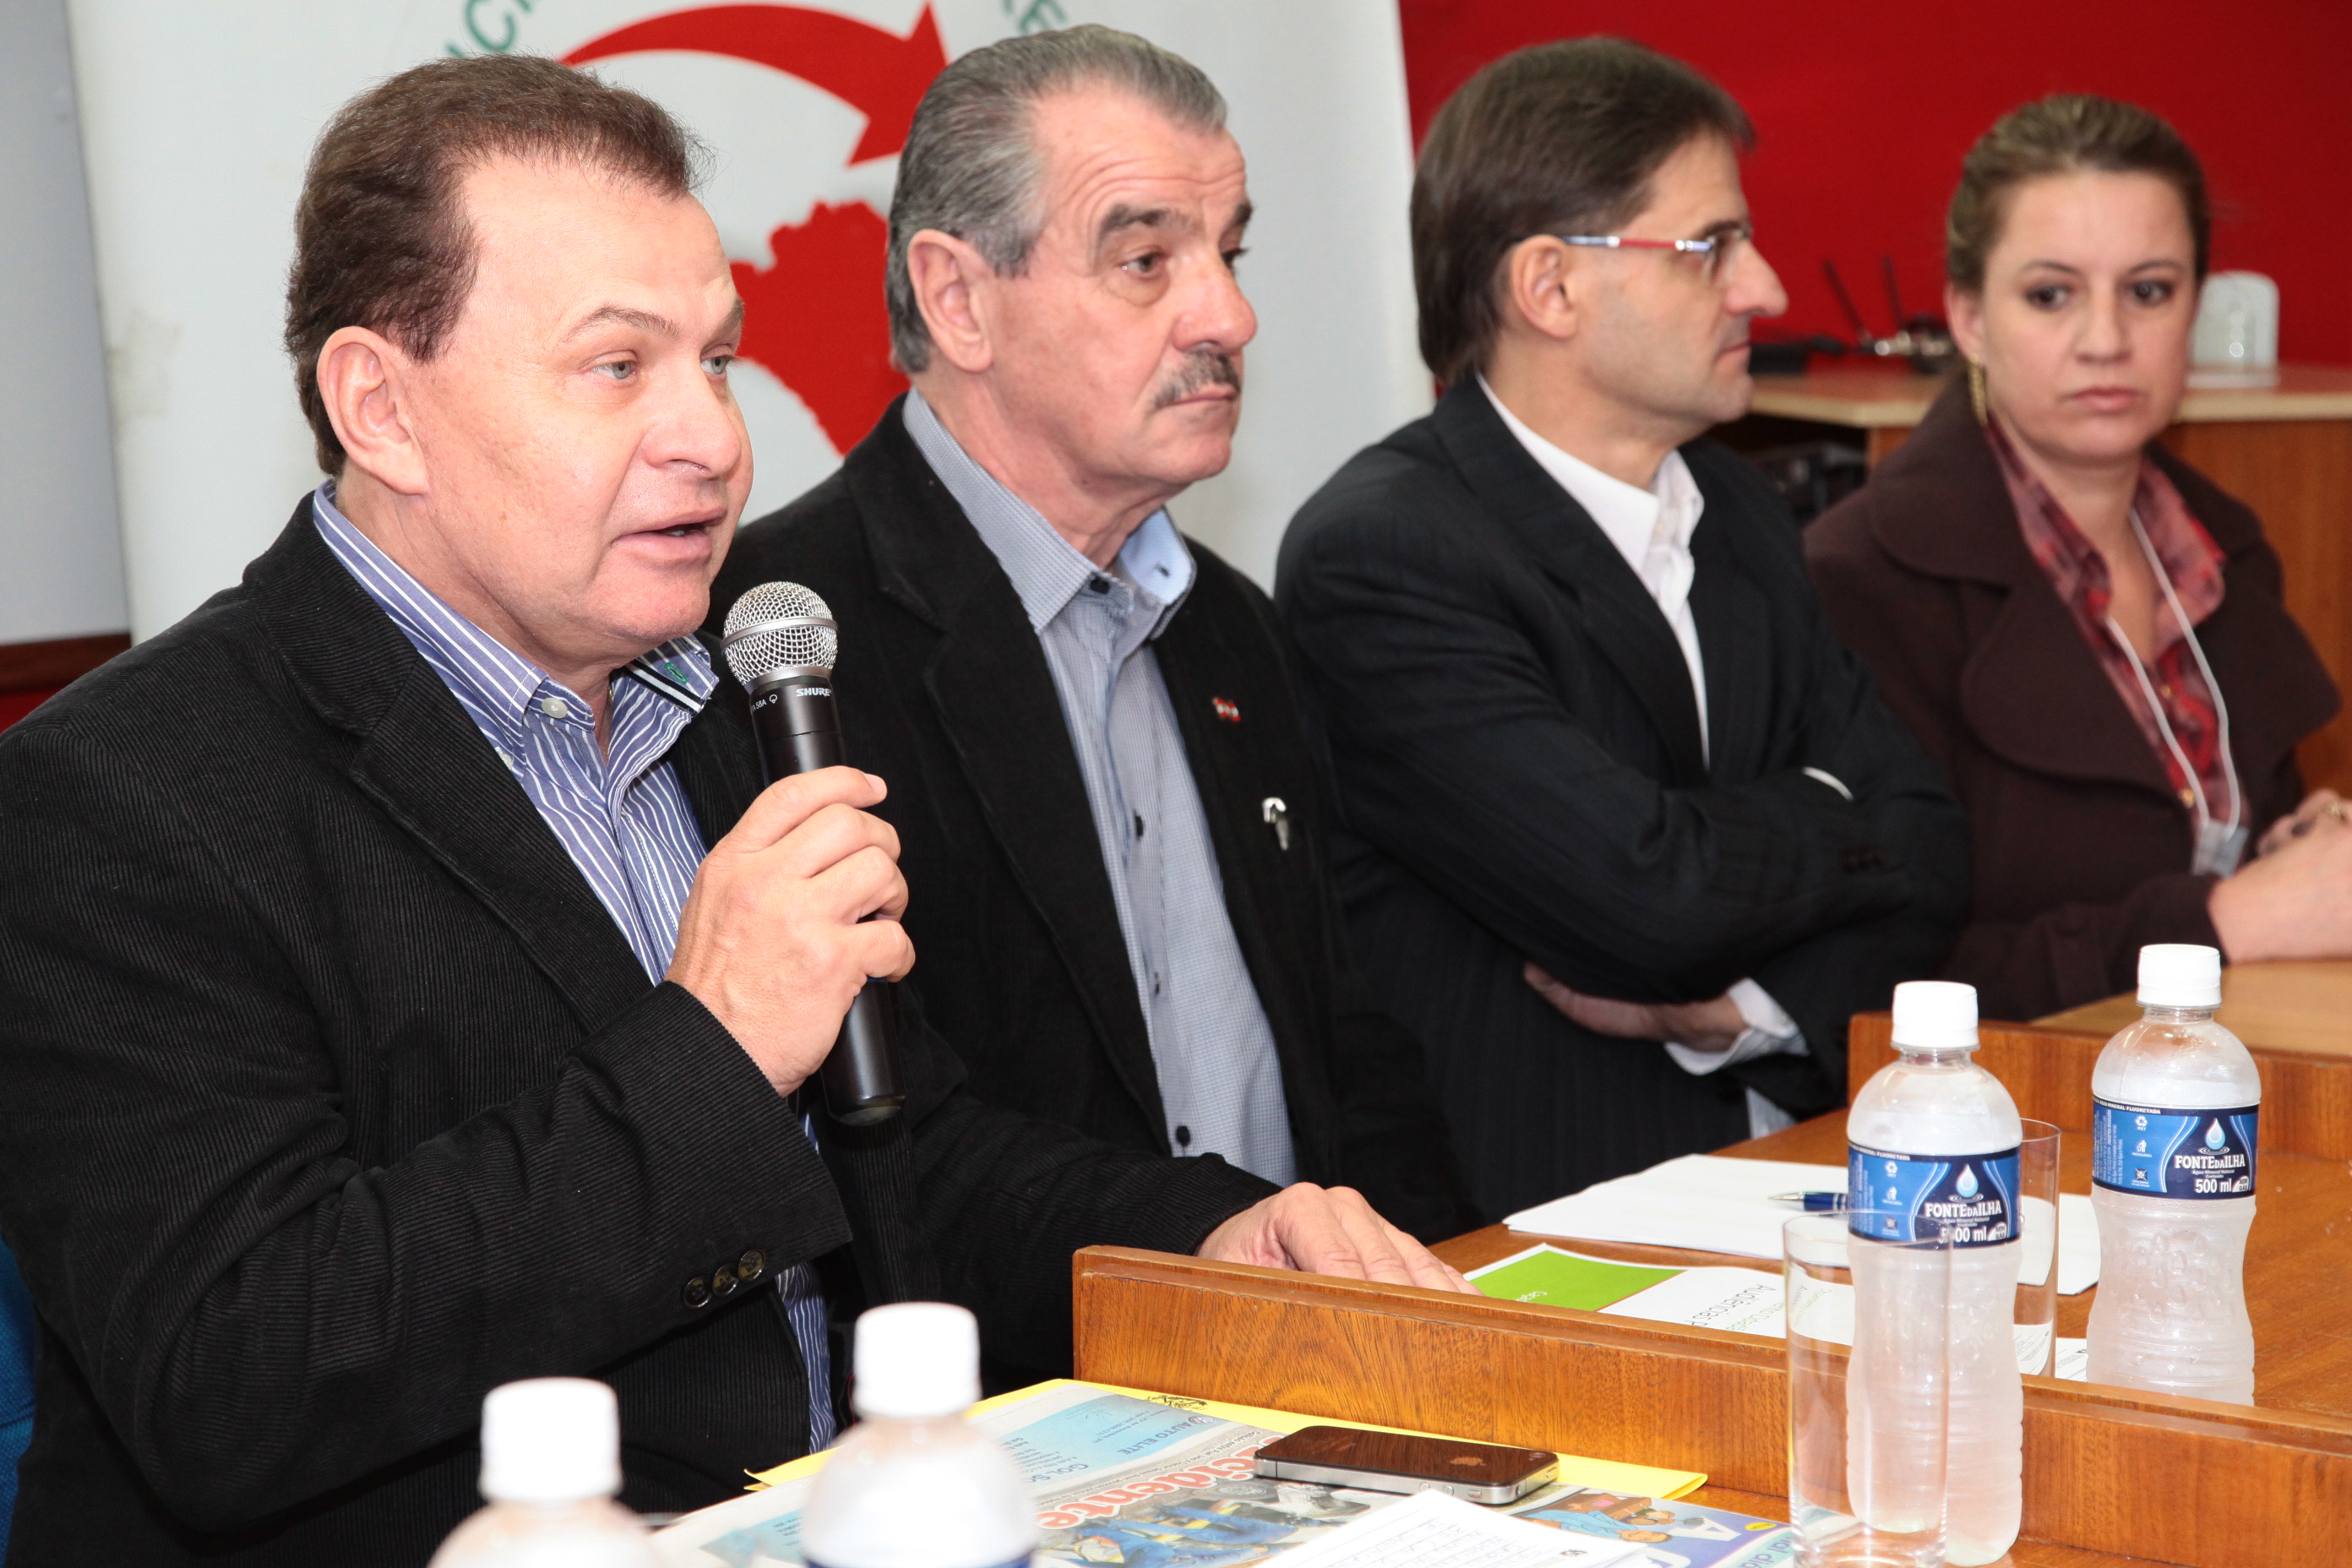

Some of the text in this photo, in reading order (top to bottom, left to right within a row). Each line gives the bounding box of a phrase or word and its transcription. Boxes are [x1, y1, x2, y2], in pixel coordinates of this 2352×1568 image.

[796, 687, 830, 697] SHURE
[2195, 1178, 2232, 1193] 500 ml
[1973, 1225, 1987, 1242] ml
[1154, 1421, 1193, 1438] AUTO
[1118, 1436, 1157, 1456] ELITE
[1037, 1436, 1283, 1528] cidente
